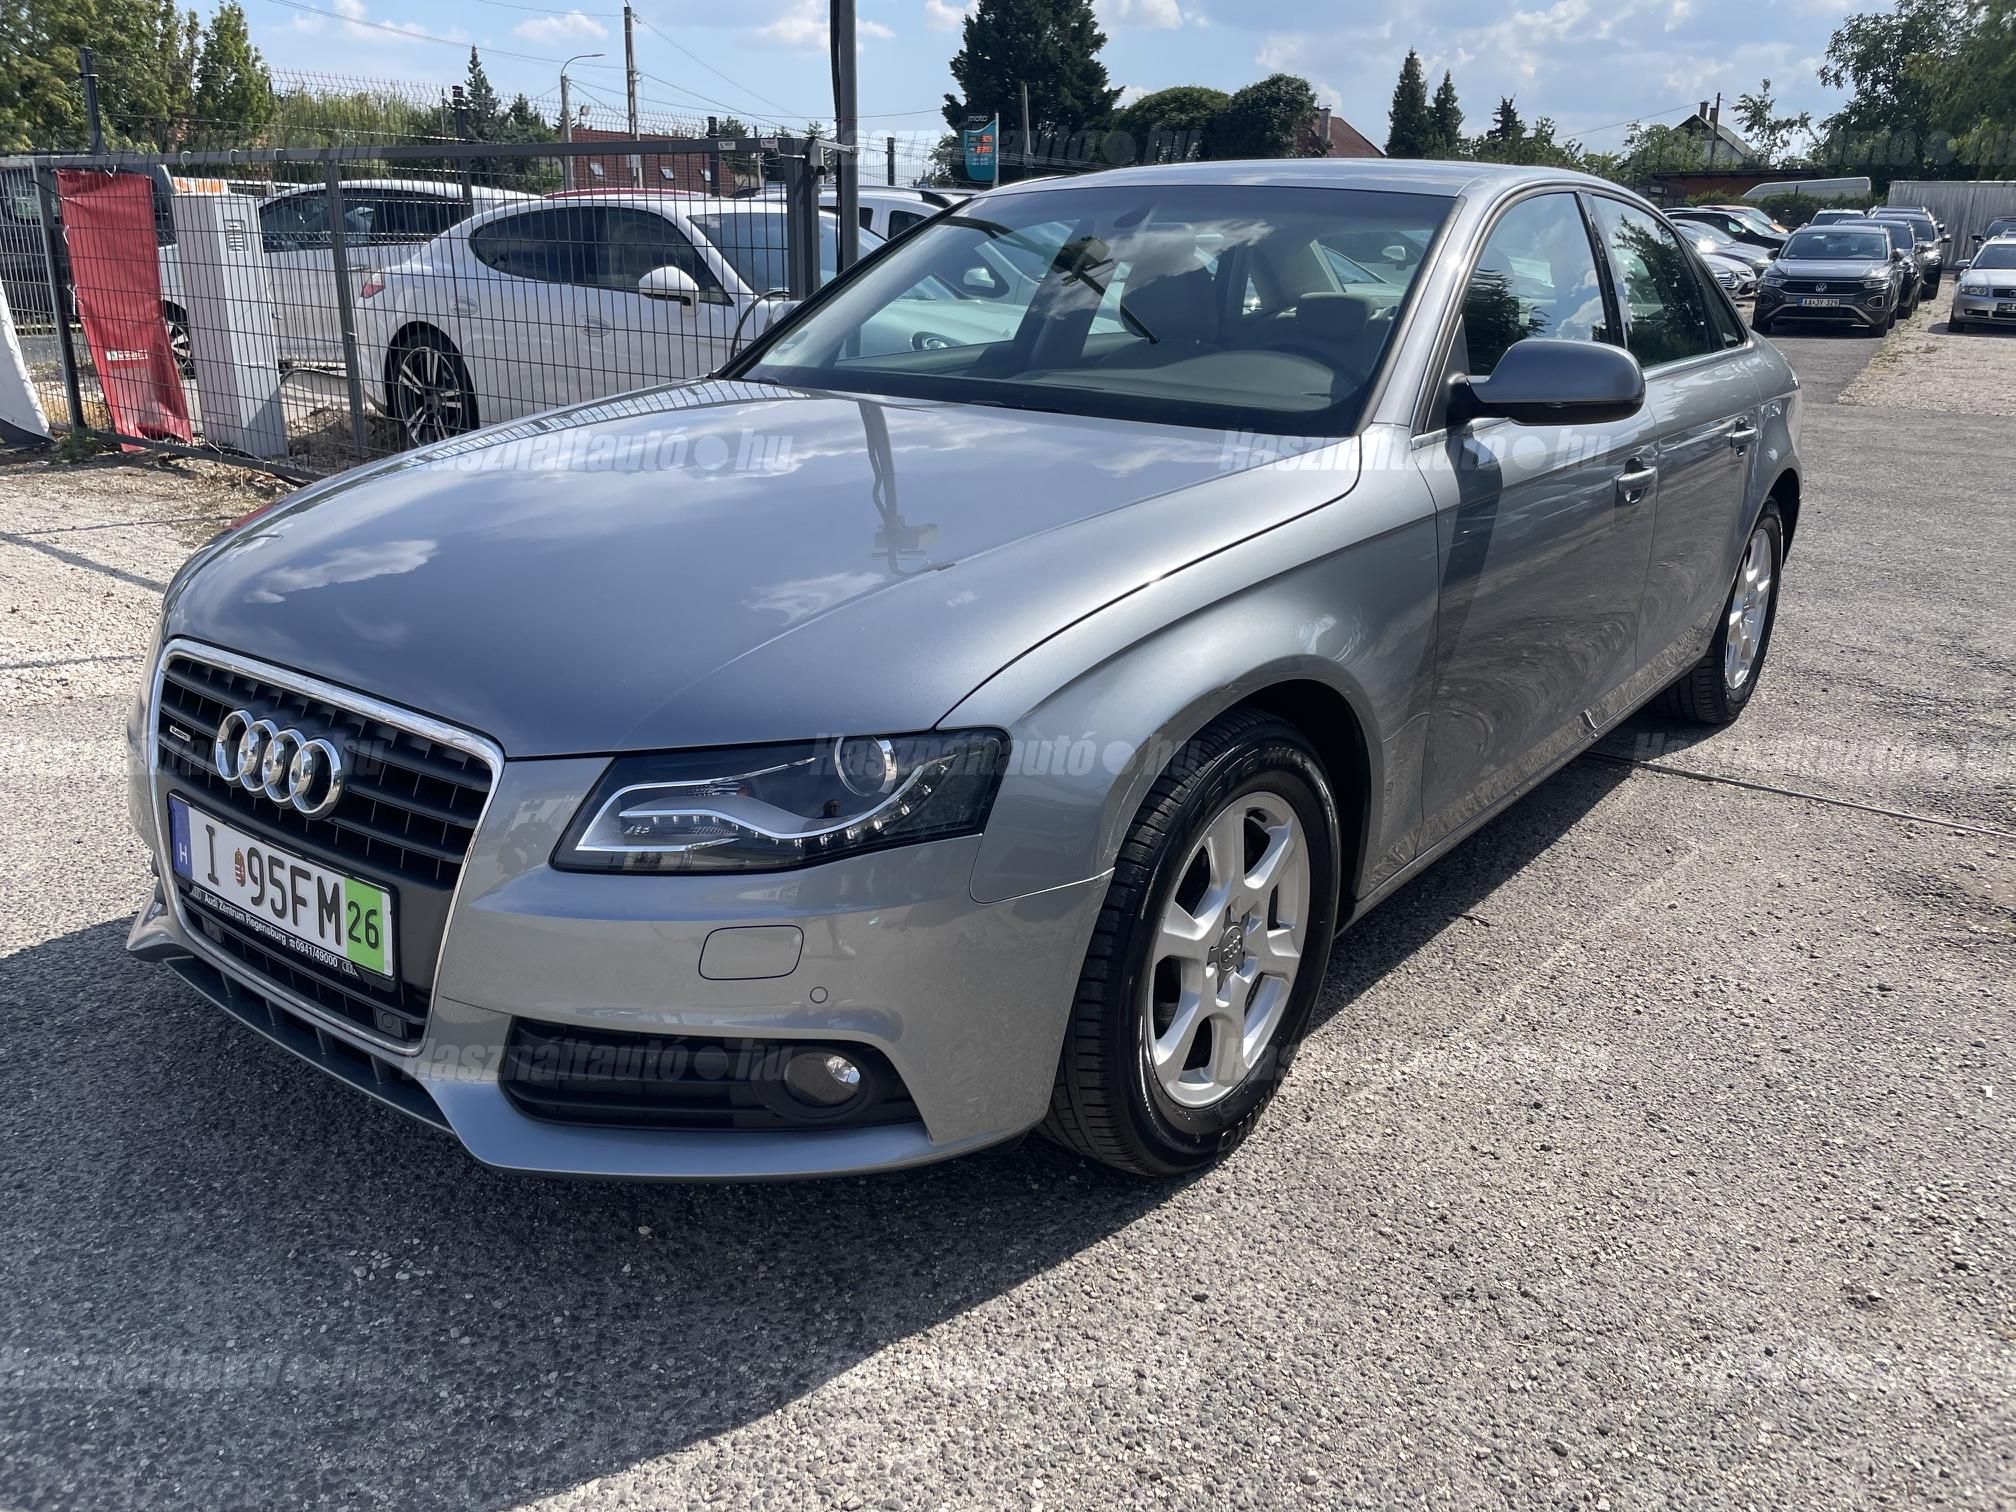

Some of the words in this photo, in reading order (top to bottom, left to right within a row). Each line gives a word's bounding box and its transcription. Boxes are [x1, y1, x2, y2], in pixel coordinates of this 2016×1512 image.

[179, 842, 188, 865] H
[205, 824, 219, 886] I
[247, 847, 341, 946] 95FM
[347, 900, 379, 949] 26
[204, 894, 219, 911] Audi
[219, 902, 245, 923] Zentrum
[246, 914, 287, 946] Regensburg
